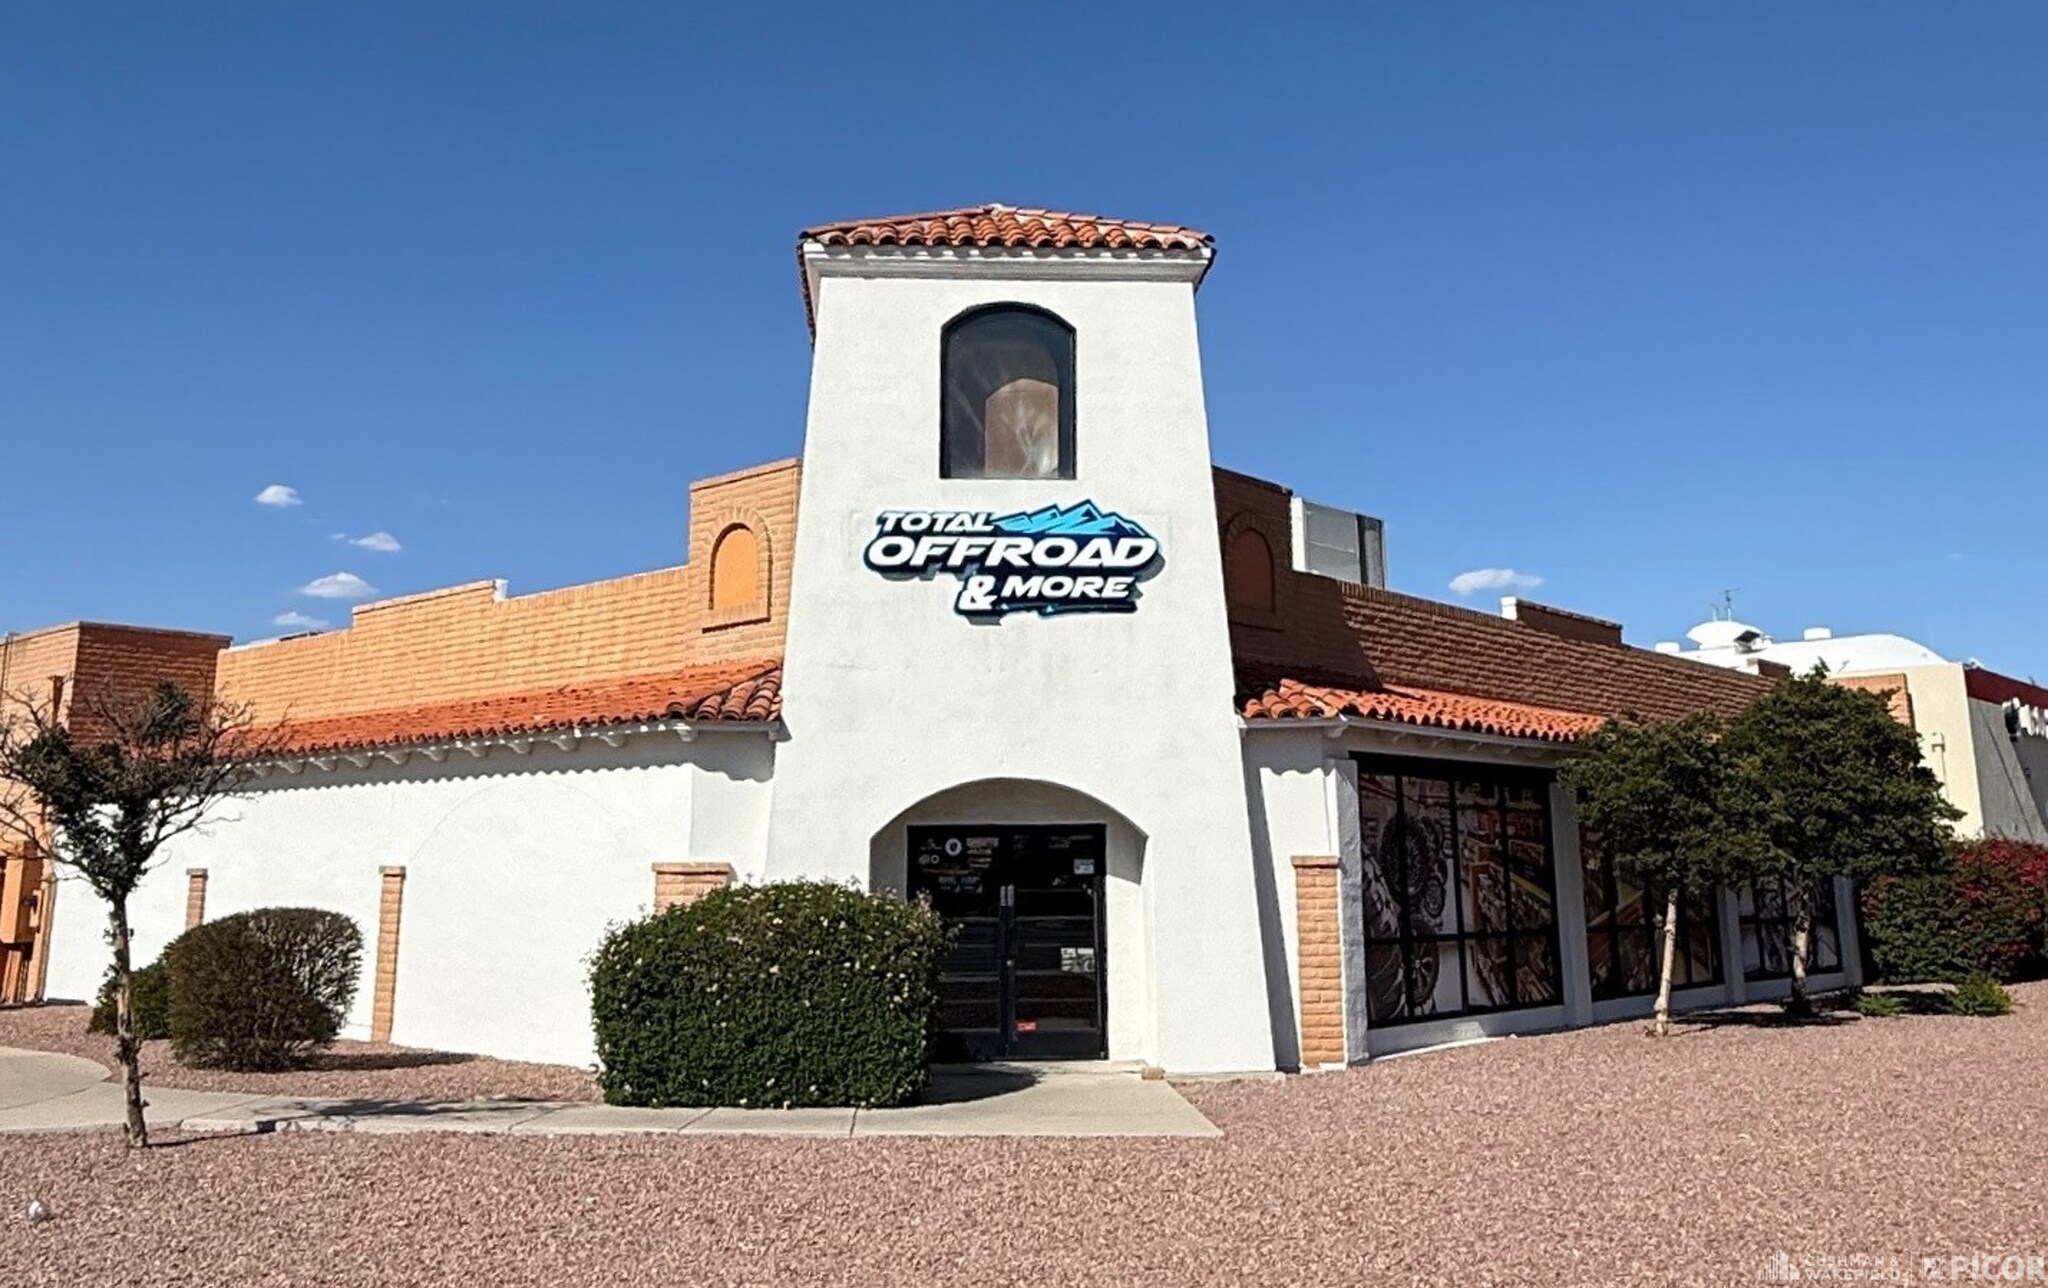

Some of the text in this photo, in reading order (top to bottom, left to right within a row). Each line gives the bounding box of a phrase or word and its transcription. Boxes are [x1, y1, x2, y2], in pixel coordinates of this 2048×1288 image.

[882, 511, 995, 532] TOTAL
[868, 536, 1158, 567] OFFROAD
[958, 574, 1136, 610] & MORE
